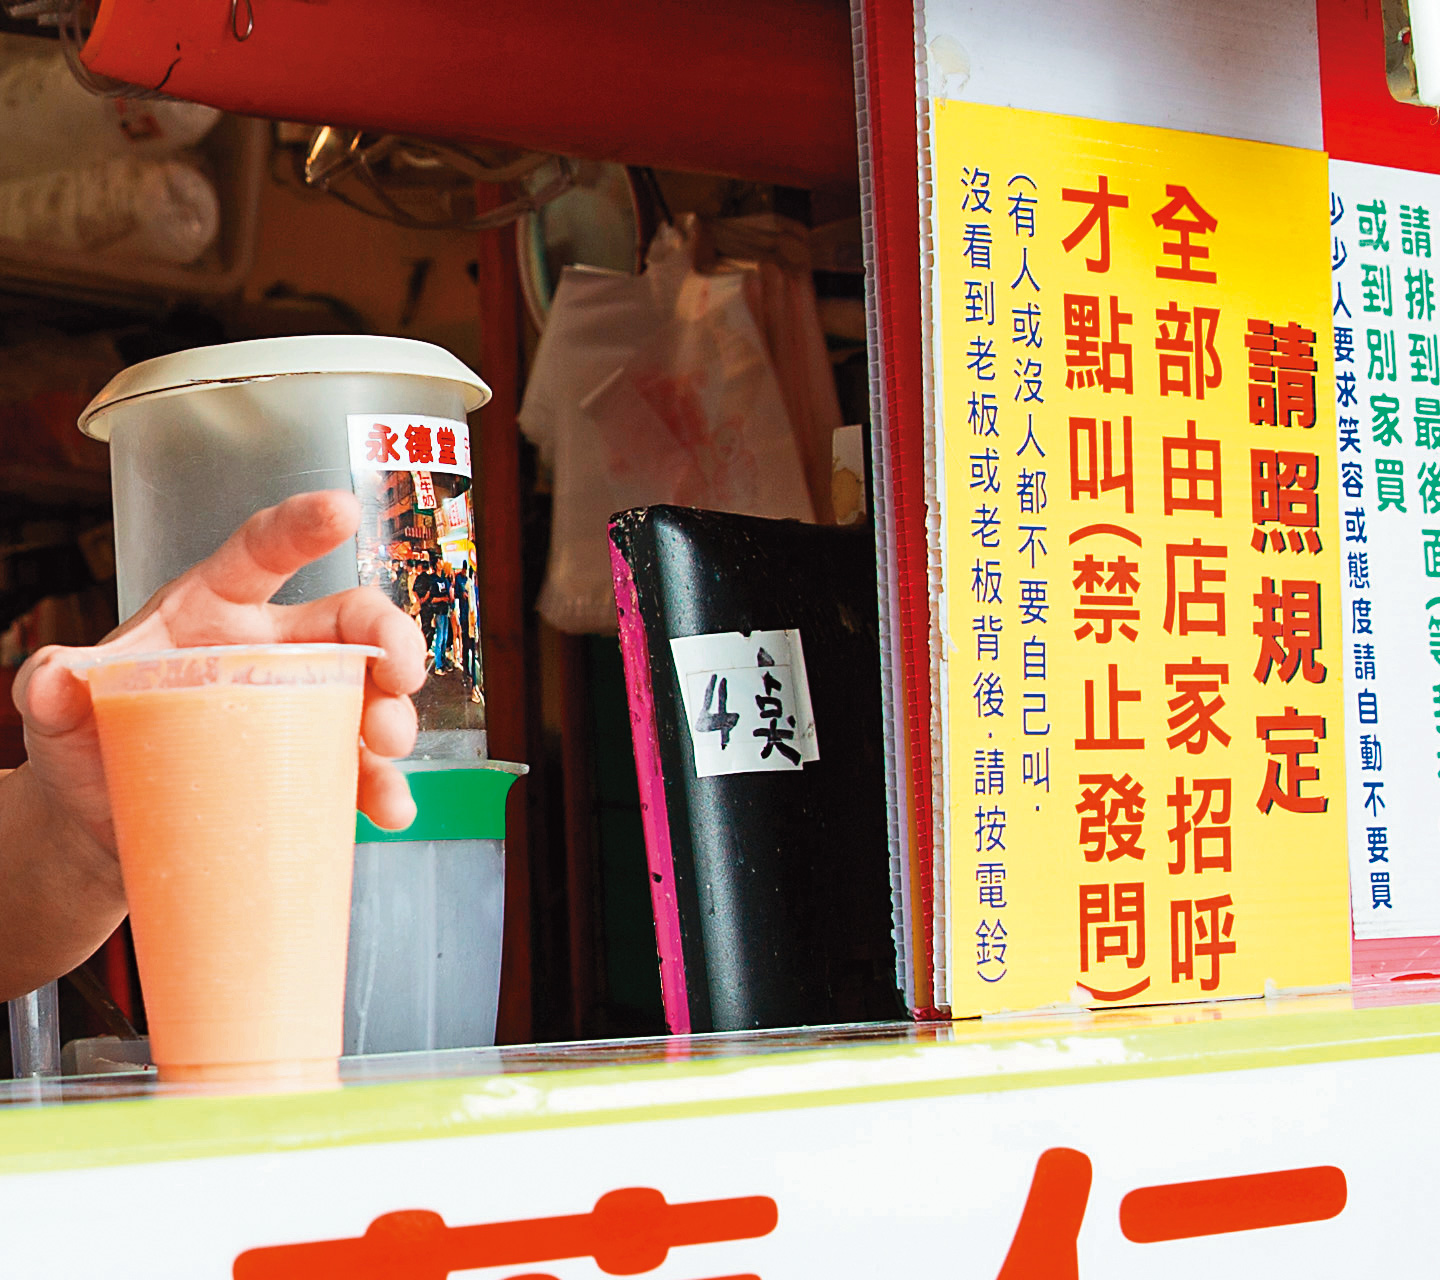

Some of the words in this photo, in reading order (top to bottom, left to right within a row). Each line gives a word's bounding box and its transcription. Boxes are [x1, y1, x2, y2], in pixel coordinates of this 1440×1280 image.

[366, 422, 458, 466] 永德堂
[1060, 174, 1151, 1002] 才點叫(禁止發問)
[1151, 183, 1238, 992] 全部由店家招呼
[1244, 318, 1328, 816] 請照規定
[1356, 198, 1408, 515] 或到別家買
